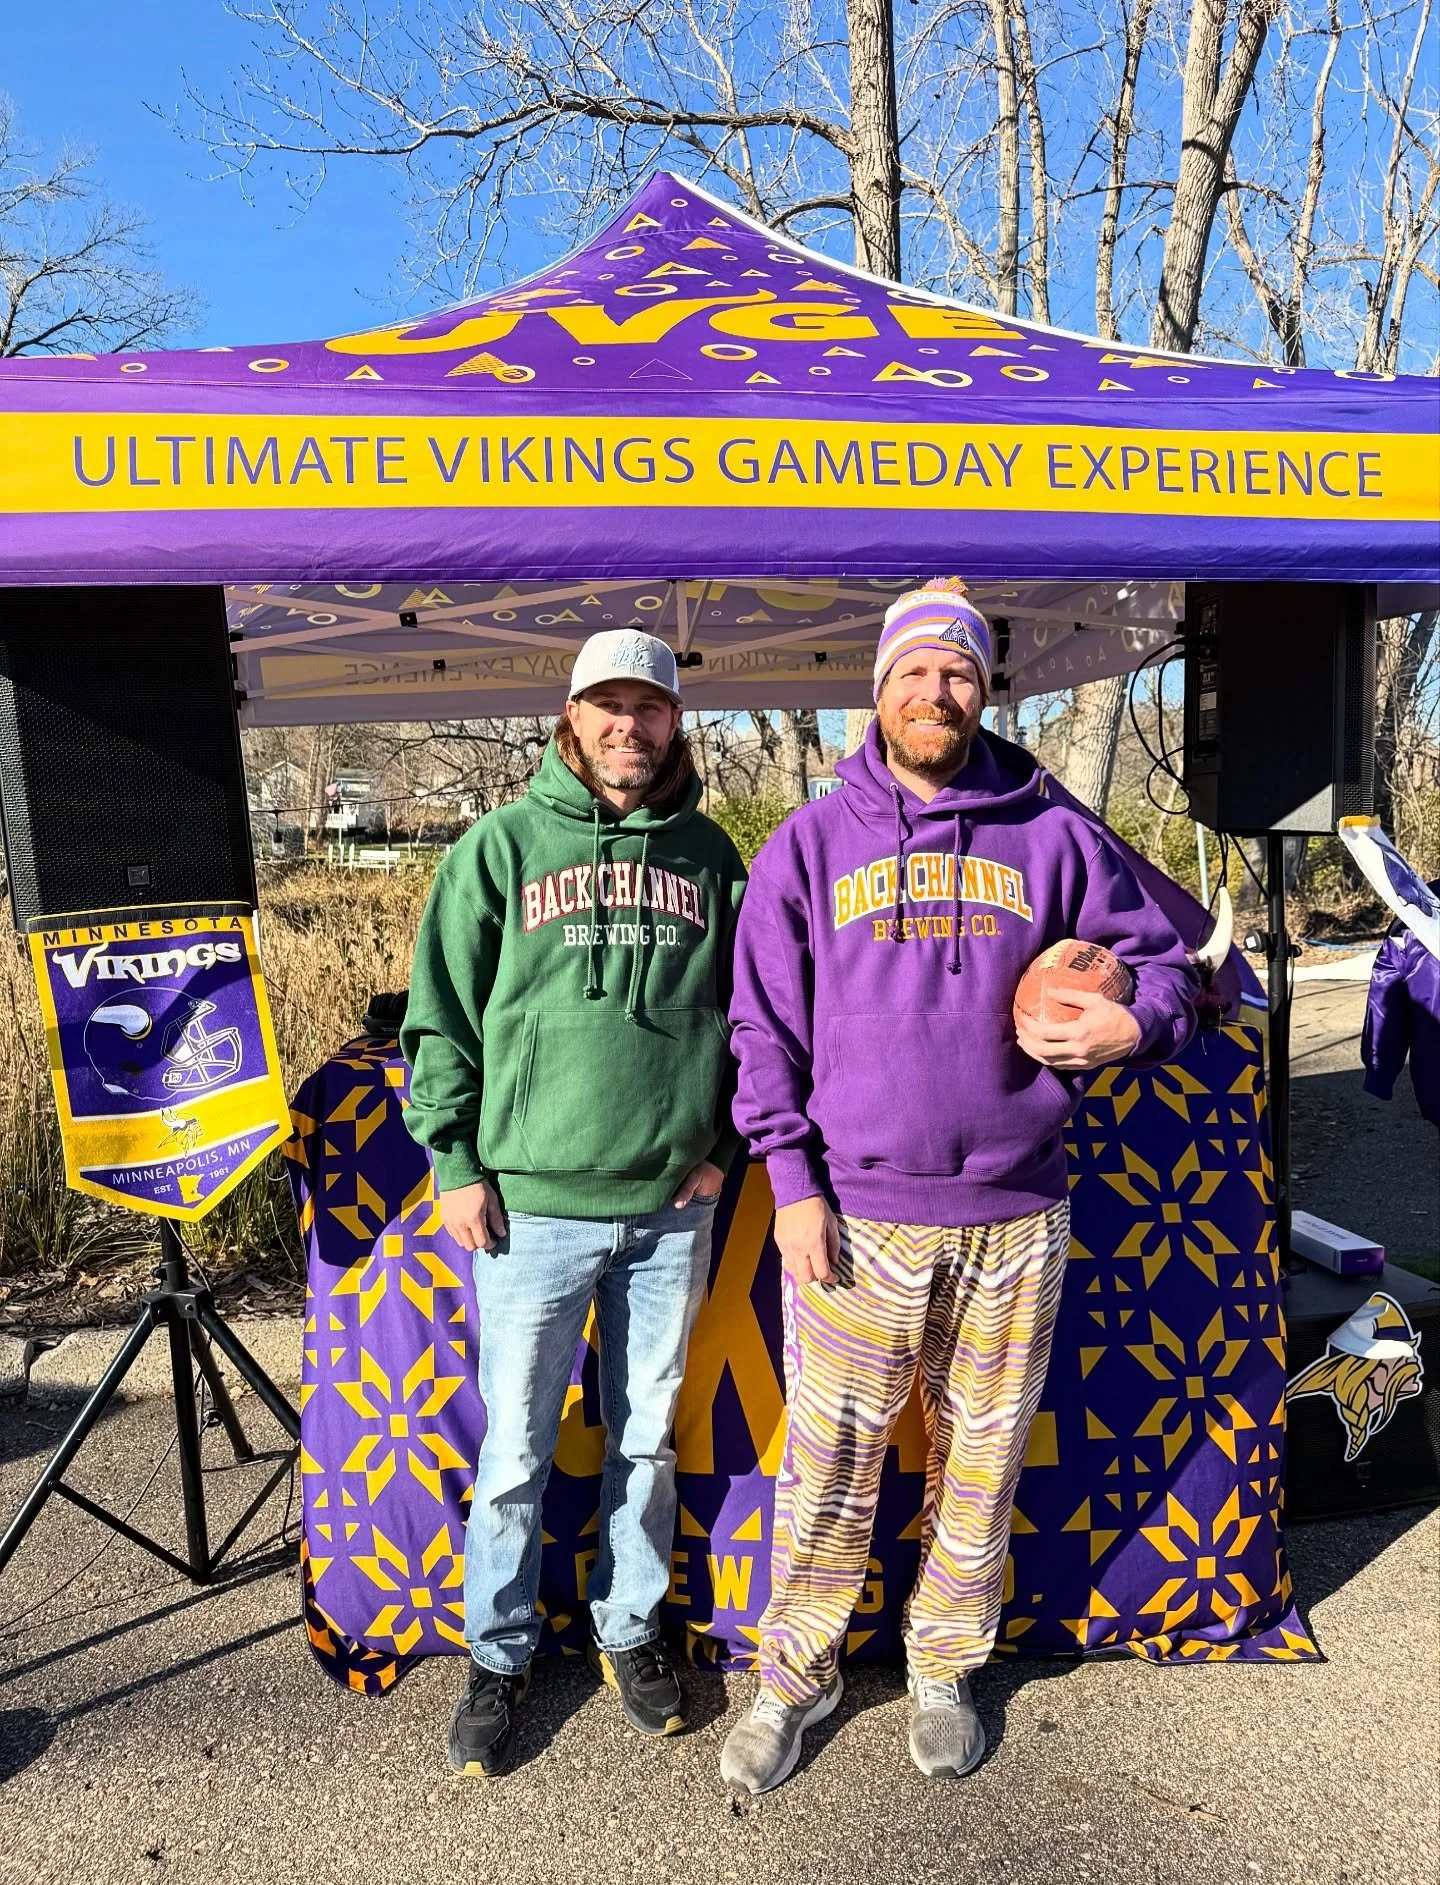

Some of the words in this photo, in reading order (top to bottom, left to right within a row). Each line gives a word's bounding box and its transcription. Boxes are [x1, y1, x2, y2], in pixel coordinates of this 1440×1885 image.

[326, 289, 1025, 355] UVGE
[73, 435, 407, 486] ULTIMATE
[427, 436, 695, 484] VIKINGS
[717, 437, 1023, 488] GAMEDAY
[1046, 444, 1384, 498] EXPERIENCE
[521, 863, 596, 934] BACK
[597, 860, 706, 931] CHANNEL
[834, 854, 906, 931] BACK
[907, 852, 1034, 923] CHANNEL
[43, 916, 243, 948] MINNESOTA
[563, 924, 650, 946] BREWING
[655, 924, 681, 946] CO.
[971, 914, 1003, 937] CO.
[112, 1151, 223, 1185] MINNEAPOLIS,
[228, 1139, 250, 1157] MN
[154, 1183, 174, 1194] EST.
[209, 1166, 230, 1179] 1961
